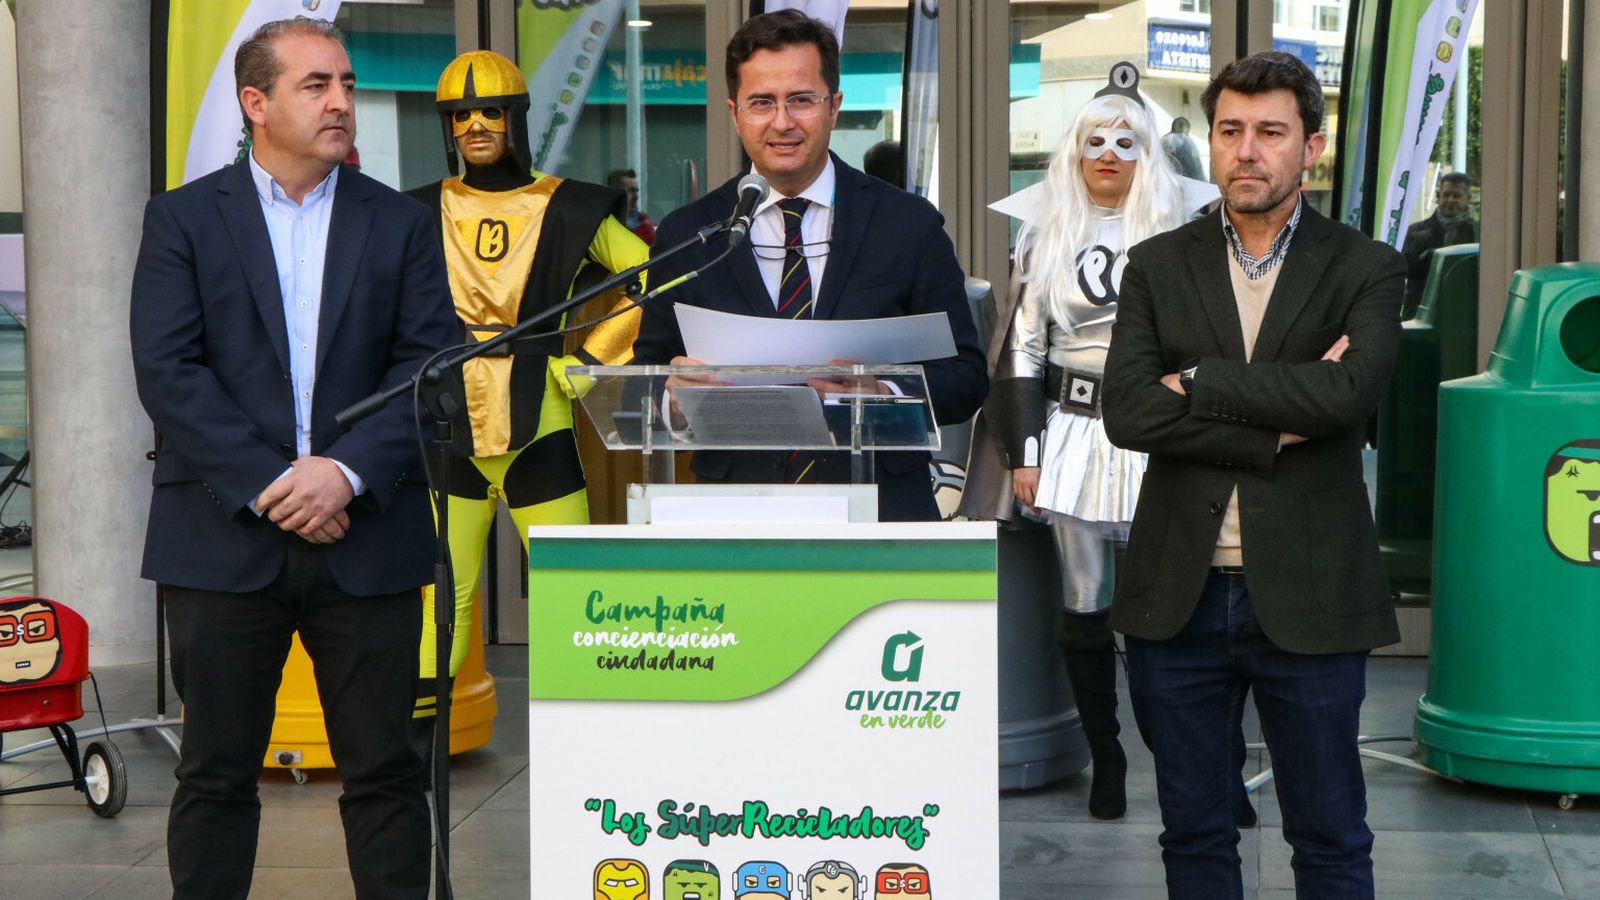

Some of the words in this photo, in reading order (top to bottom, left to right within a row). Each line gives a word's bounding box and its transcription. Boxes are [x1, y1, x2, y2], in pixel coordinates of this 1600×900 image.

[586, 590, 725, 632] Campaña
[573, 624, 739, 649] concienciación
[597, 649, 714, 671] ciudadana
[845, 690, 960, 711] avanza
[860, 714, 885, 729] en
[888, 708, 947, 729] verde
